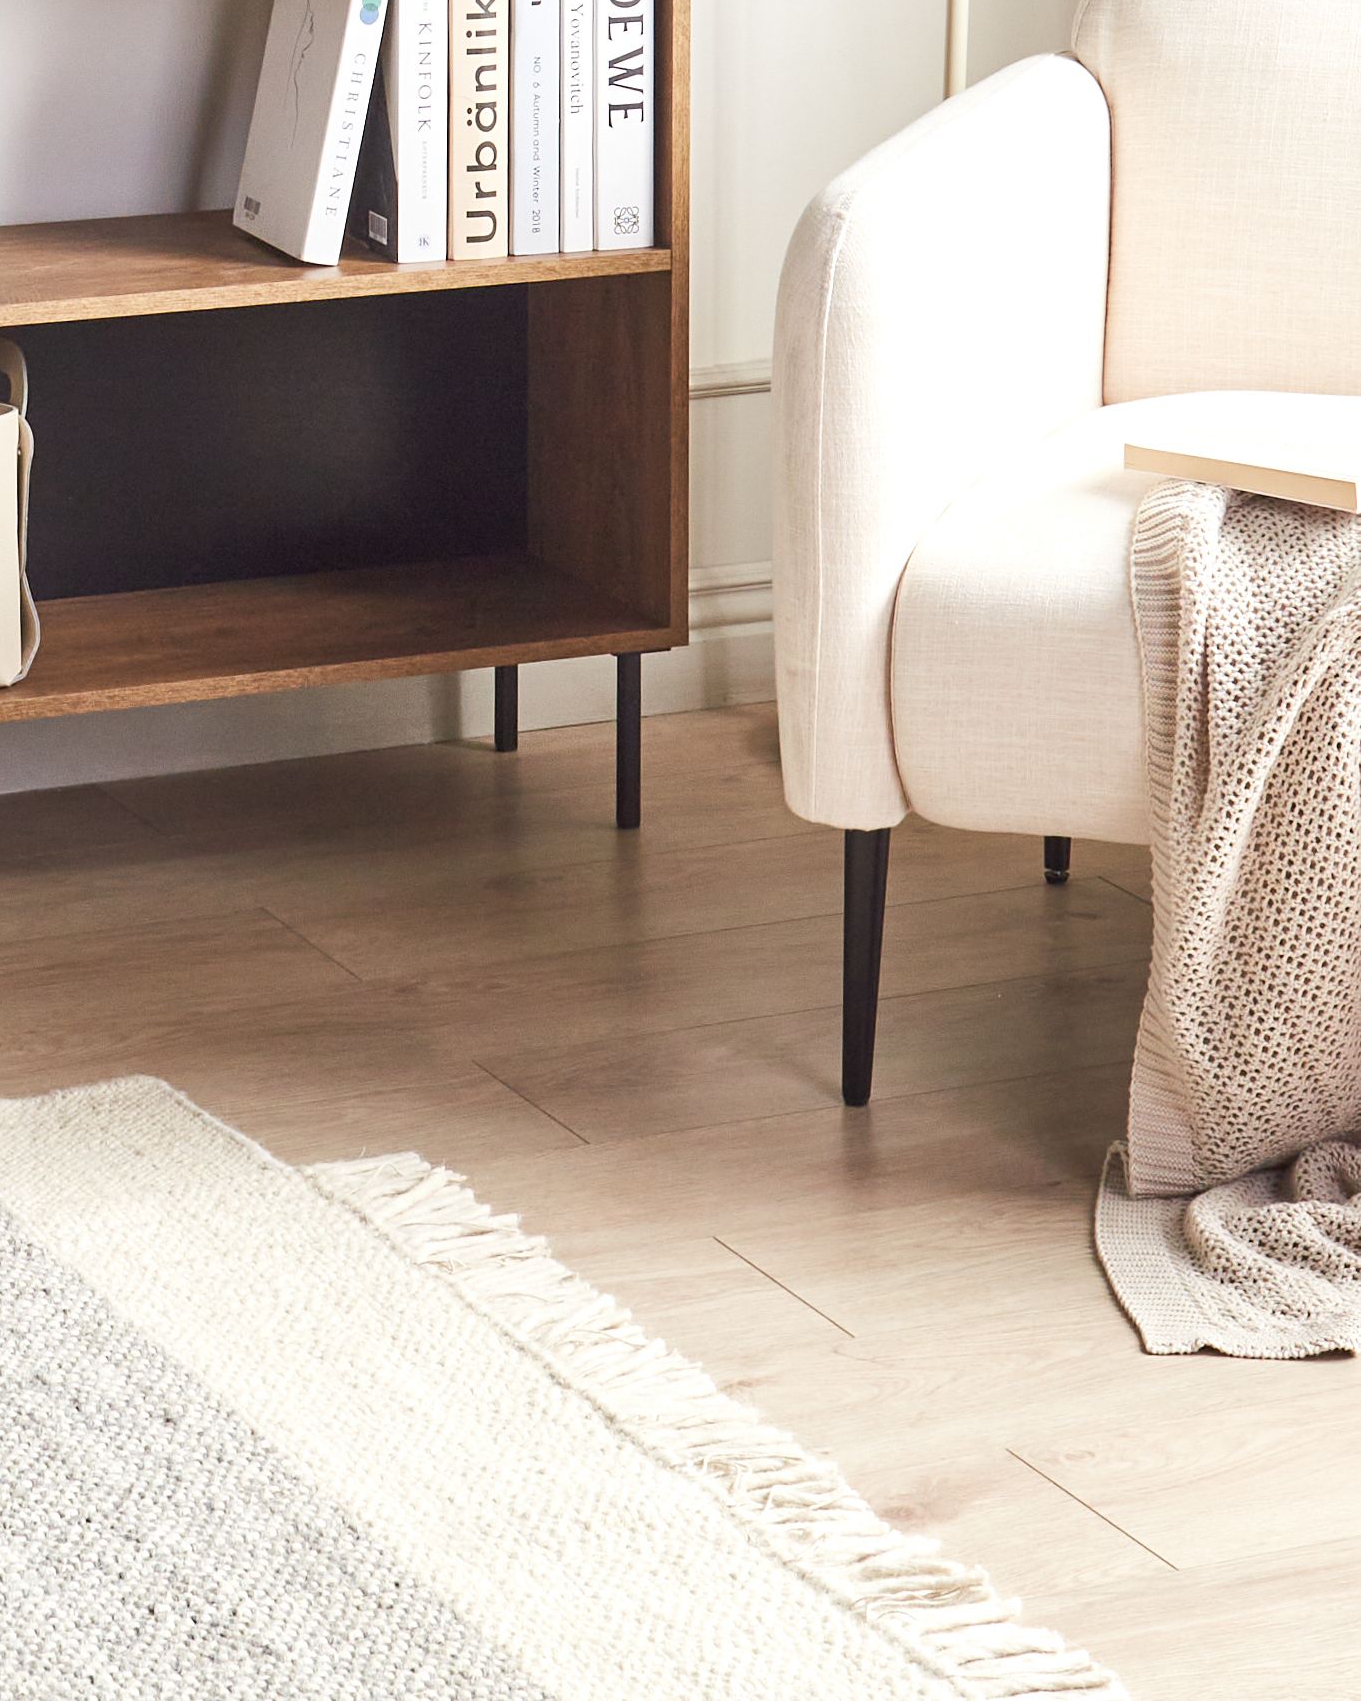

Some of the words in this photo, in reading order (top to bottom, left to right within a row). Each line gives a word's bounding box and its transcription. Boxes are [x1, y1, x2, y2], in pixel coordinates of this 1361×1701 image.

[417, 22, 433, 133] KINFOLK
[569, 3, 584, 115] Yovanovitch
[531, 81, 541, 89] 6
[324, 52, 367, 218] CHRISTIANE
[532, 93, 542, 137] Autumn
[532, 139, 542, 162] and
[531, 165, 542, 204] Winter
[531, 208, 542, 235] 2018
